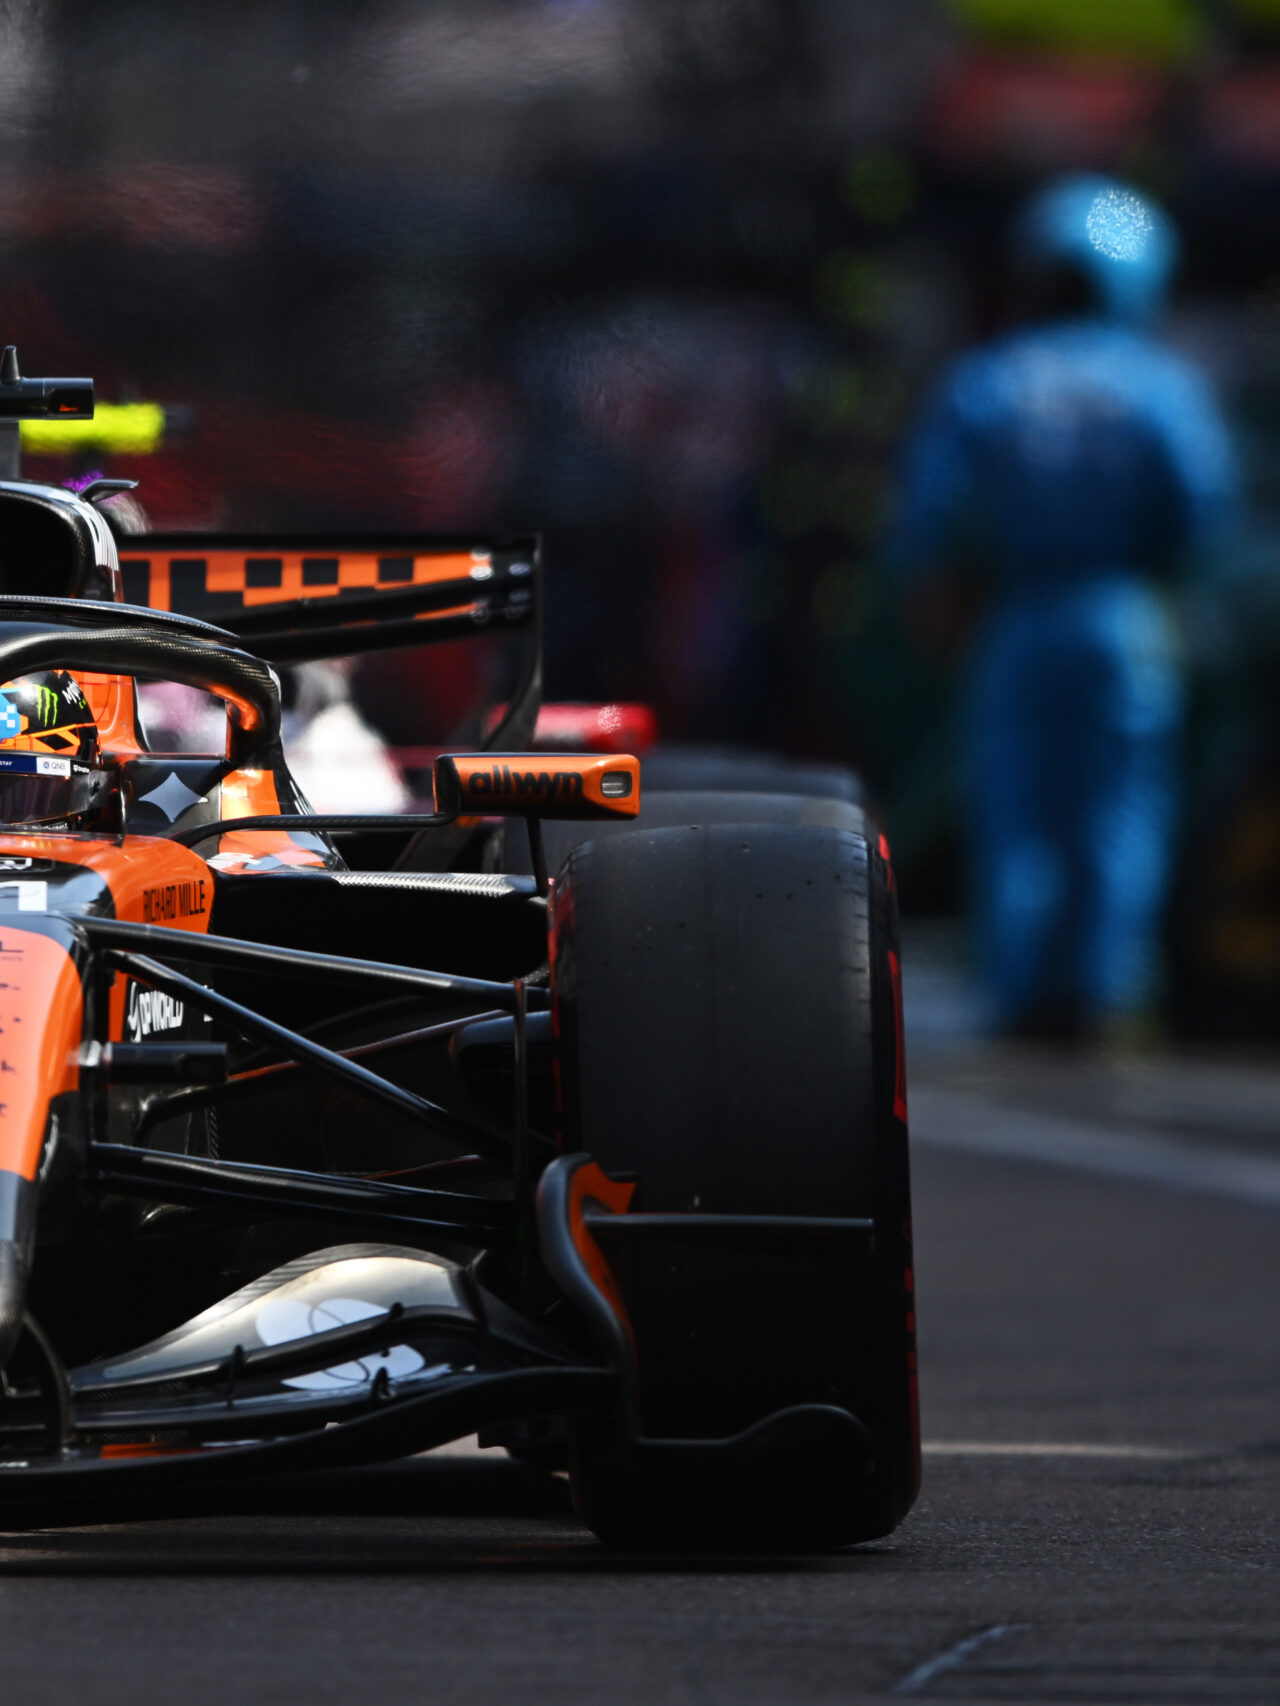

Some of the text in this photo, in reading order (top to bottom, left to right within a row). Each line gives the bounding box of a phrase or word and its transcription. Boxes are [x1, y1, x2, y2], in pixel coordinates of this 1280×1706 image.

[50, 761, 67, 771] QNB
[469, 765, 583, 799] allwyn
[143, 880, 205, 923] RICHARD MILLE
